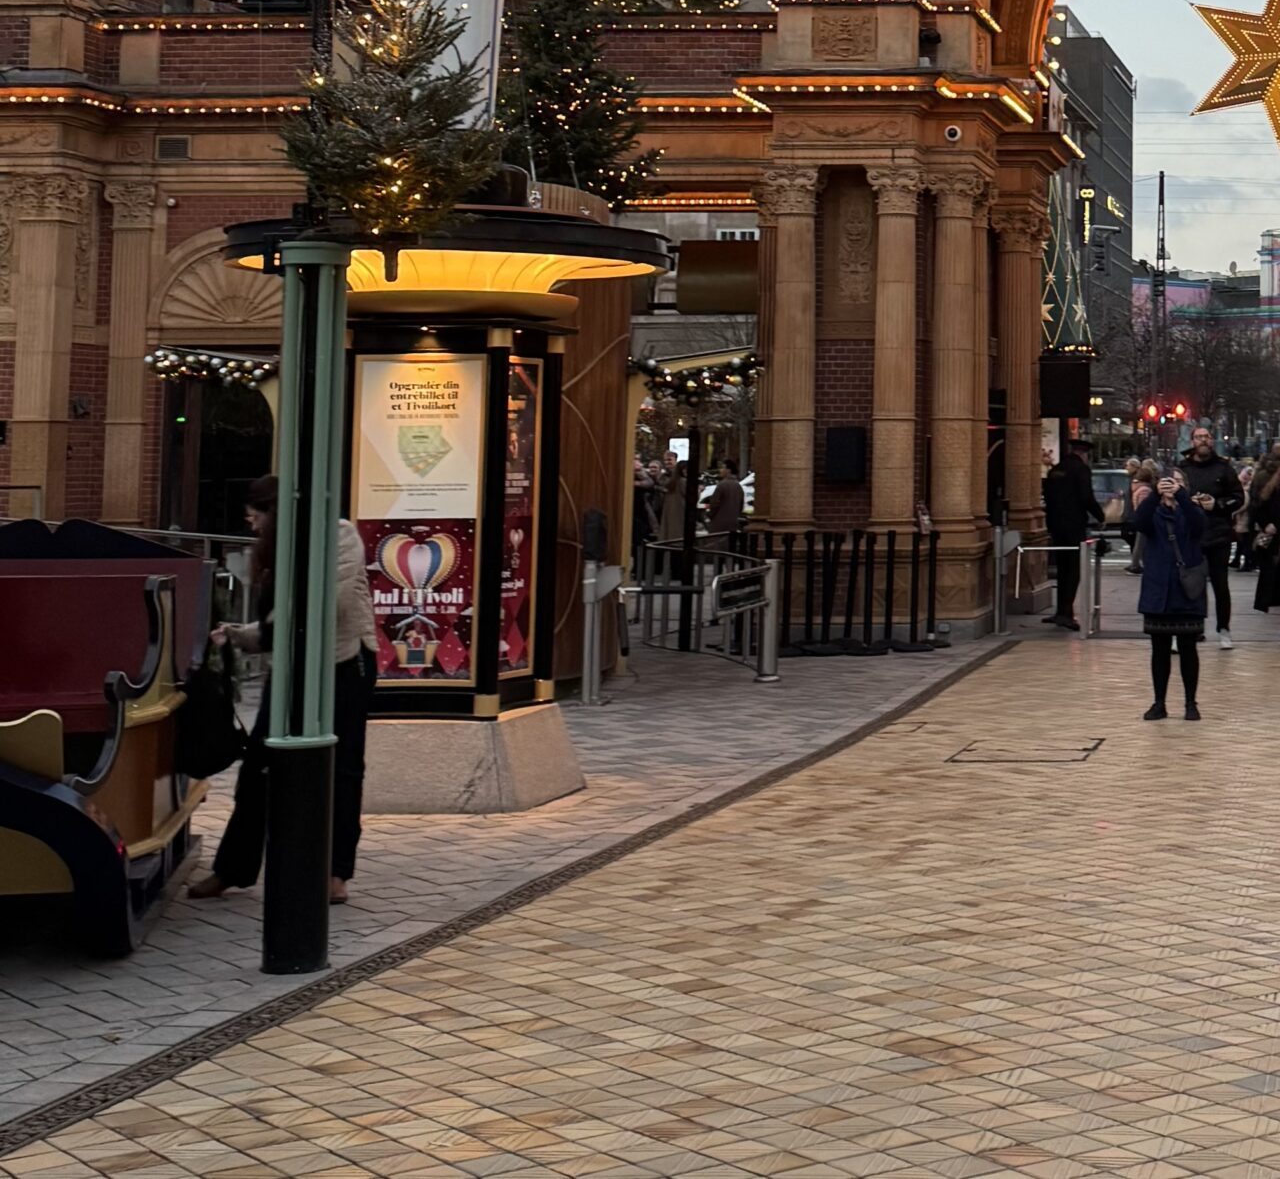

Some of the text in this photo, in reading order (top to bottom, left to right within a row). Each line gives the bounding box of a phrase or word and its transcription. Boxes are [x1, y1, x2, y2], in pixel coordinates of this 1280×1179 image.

[389, 380, 460, 391] Opgradér din
[390, 391, 459, 400] entrébillet til
[391, 401, 456, 410] et Tivolikort
[373, 588, 464, 604] Jul i Tivoli
